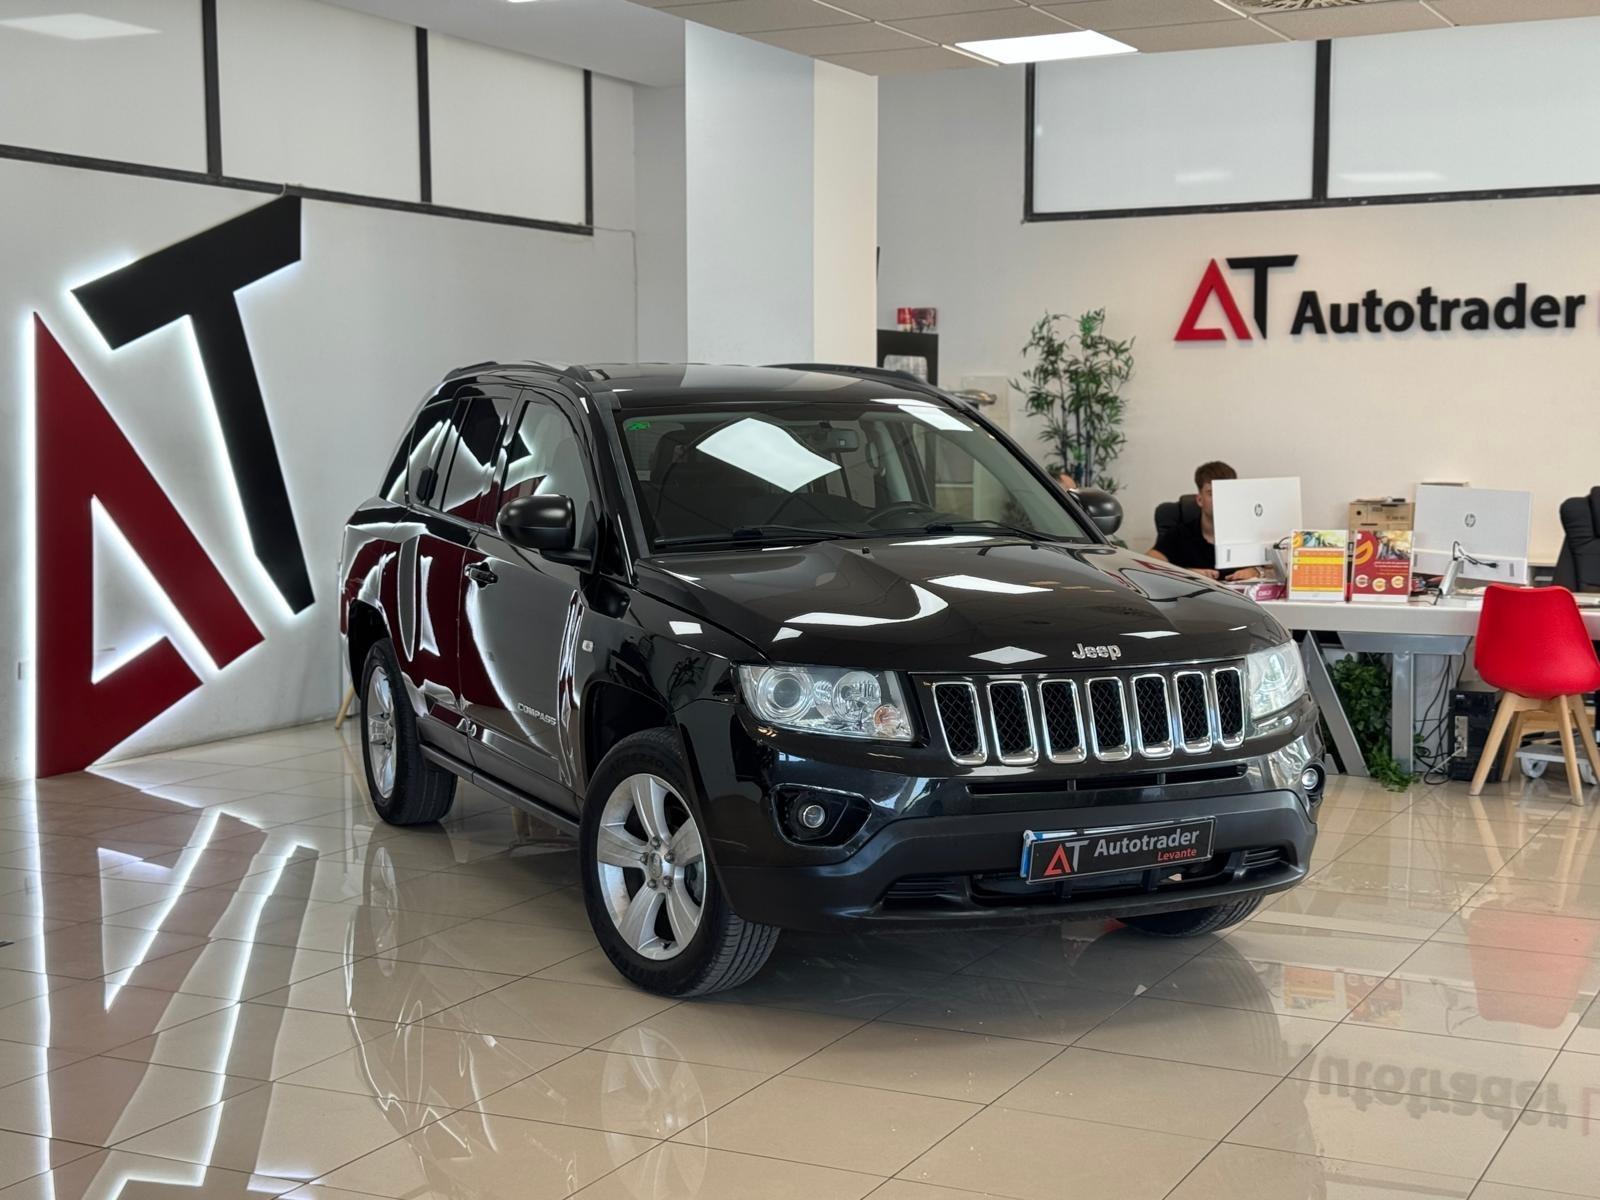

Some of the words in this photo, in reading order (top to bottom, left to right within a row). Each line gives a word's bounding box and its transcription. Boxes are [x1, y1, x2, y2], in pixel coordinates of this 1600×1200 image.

[1174, 254, 1299, 342] AT
[1290, 282, 1587, 336] Autotrader
[35, 195, 316, 779] AT
[1071, 642, 1122, 661] Jeep
[517, 702, 557, 726] COMPASS
[1043, 839, 1090, 877] AT
[1093, 828, 1200, 857] Autotrader
[1157, 847, 1197, 862] Levante
